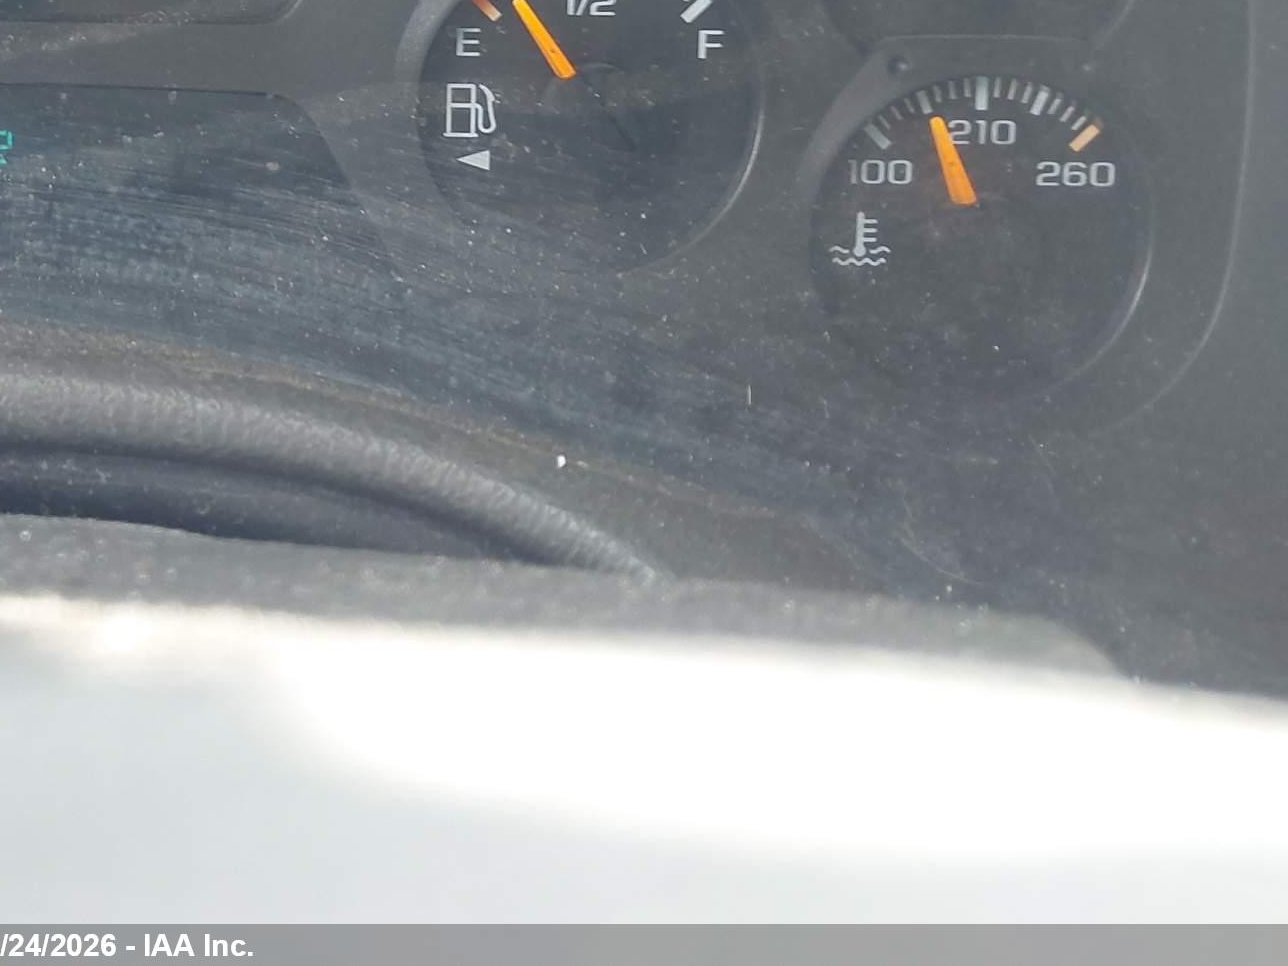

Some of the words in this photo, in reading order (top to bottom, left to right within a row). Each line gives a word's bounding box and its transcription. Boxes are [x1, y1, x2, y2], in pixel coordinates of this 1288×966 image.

[456, 29, 480, 57] E
[697, 30, 724, 59] F
[948, 119, 1017, 145] 210
[847, 159, 912, 185] 100
[1035, 161, 1116, 187] 260
